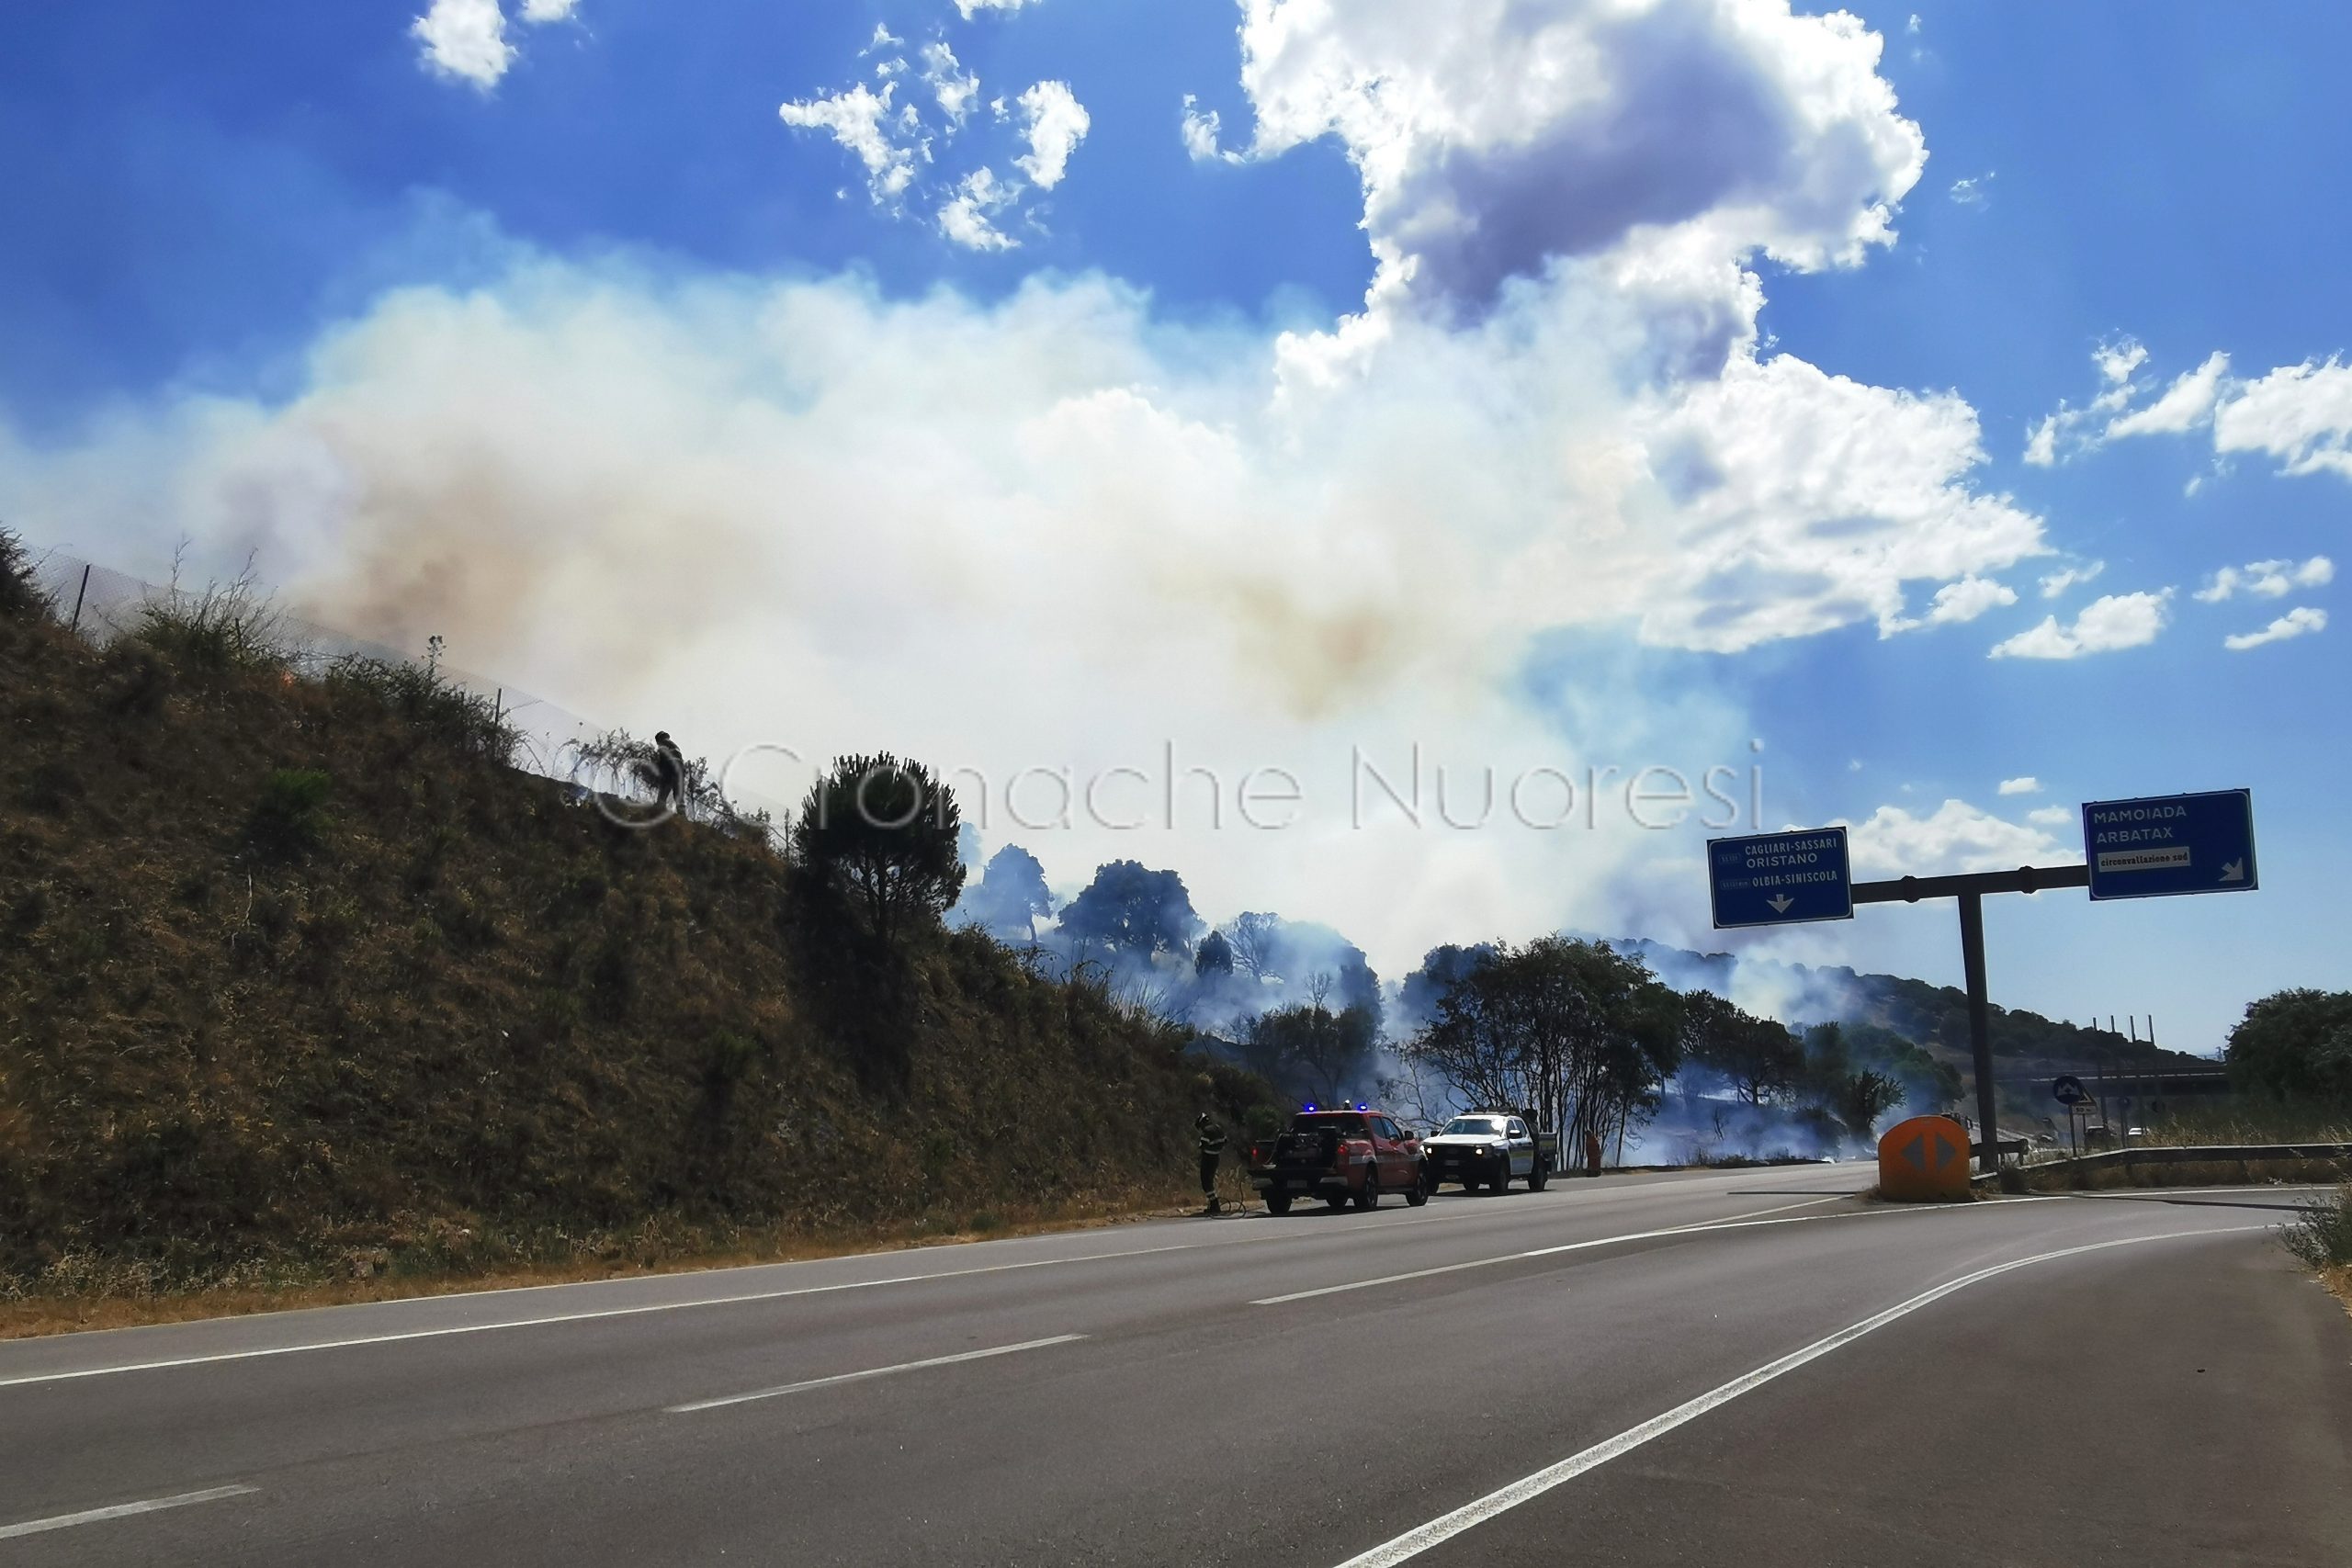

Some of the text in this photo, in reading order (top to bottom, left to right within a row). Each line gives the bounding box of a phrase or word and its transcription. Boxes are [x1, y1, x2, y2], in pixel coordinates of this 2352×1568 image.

[2094, 805, 2188, 824] MAMOIADA
[2096, 827, 2174, 844] ARBATAX
[1744, 837, 1838, 856] CAGLIARI-SASSARI
[1746, 852, 1818, 869] ORISTANO
[2100, 851, 2188, 867] circonvallazione sud
[1752, 870, 1838, 888] OLBIA-SINISCOLA
